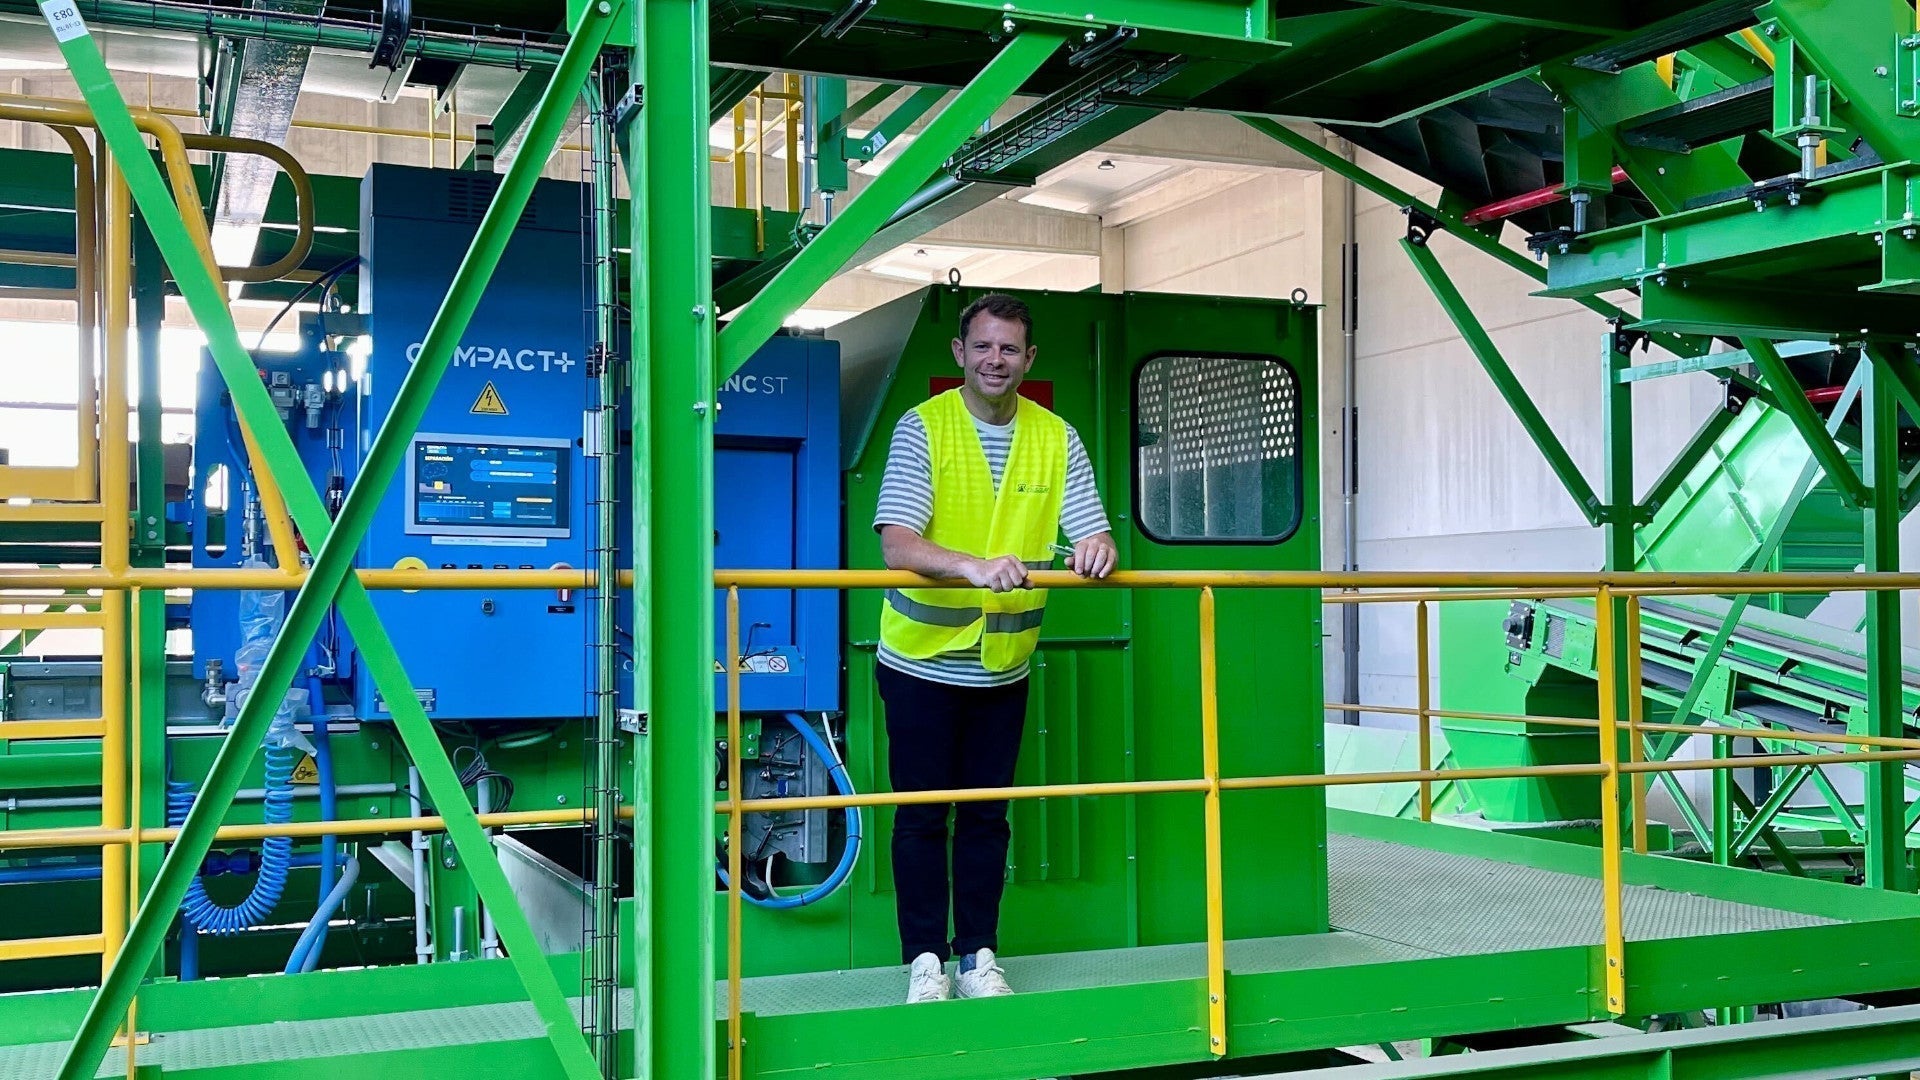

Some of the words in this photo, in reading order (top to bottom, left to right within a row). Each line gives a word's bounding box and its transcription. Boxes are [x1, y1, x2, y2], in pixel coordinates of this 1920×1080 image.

[53, 8, 73, 20] 083
[405, 342, 576, 373] CMPACT+
[762, 376, 788, 394] ST
